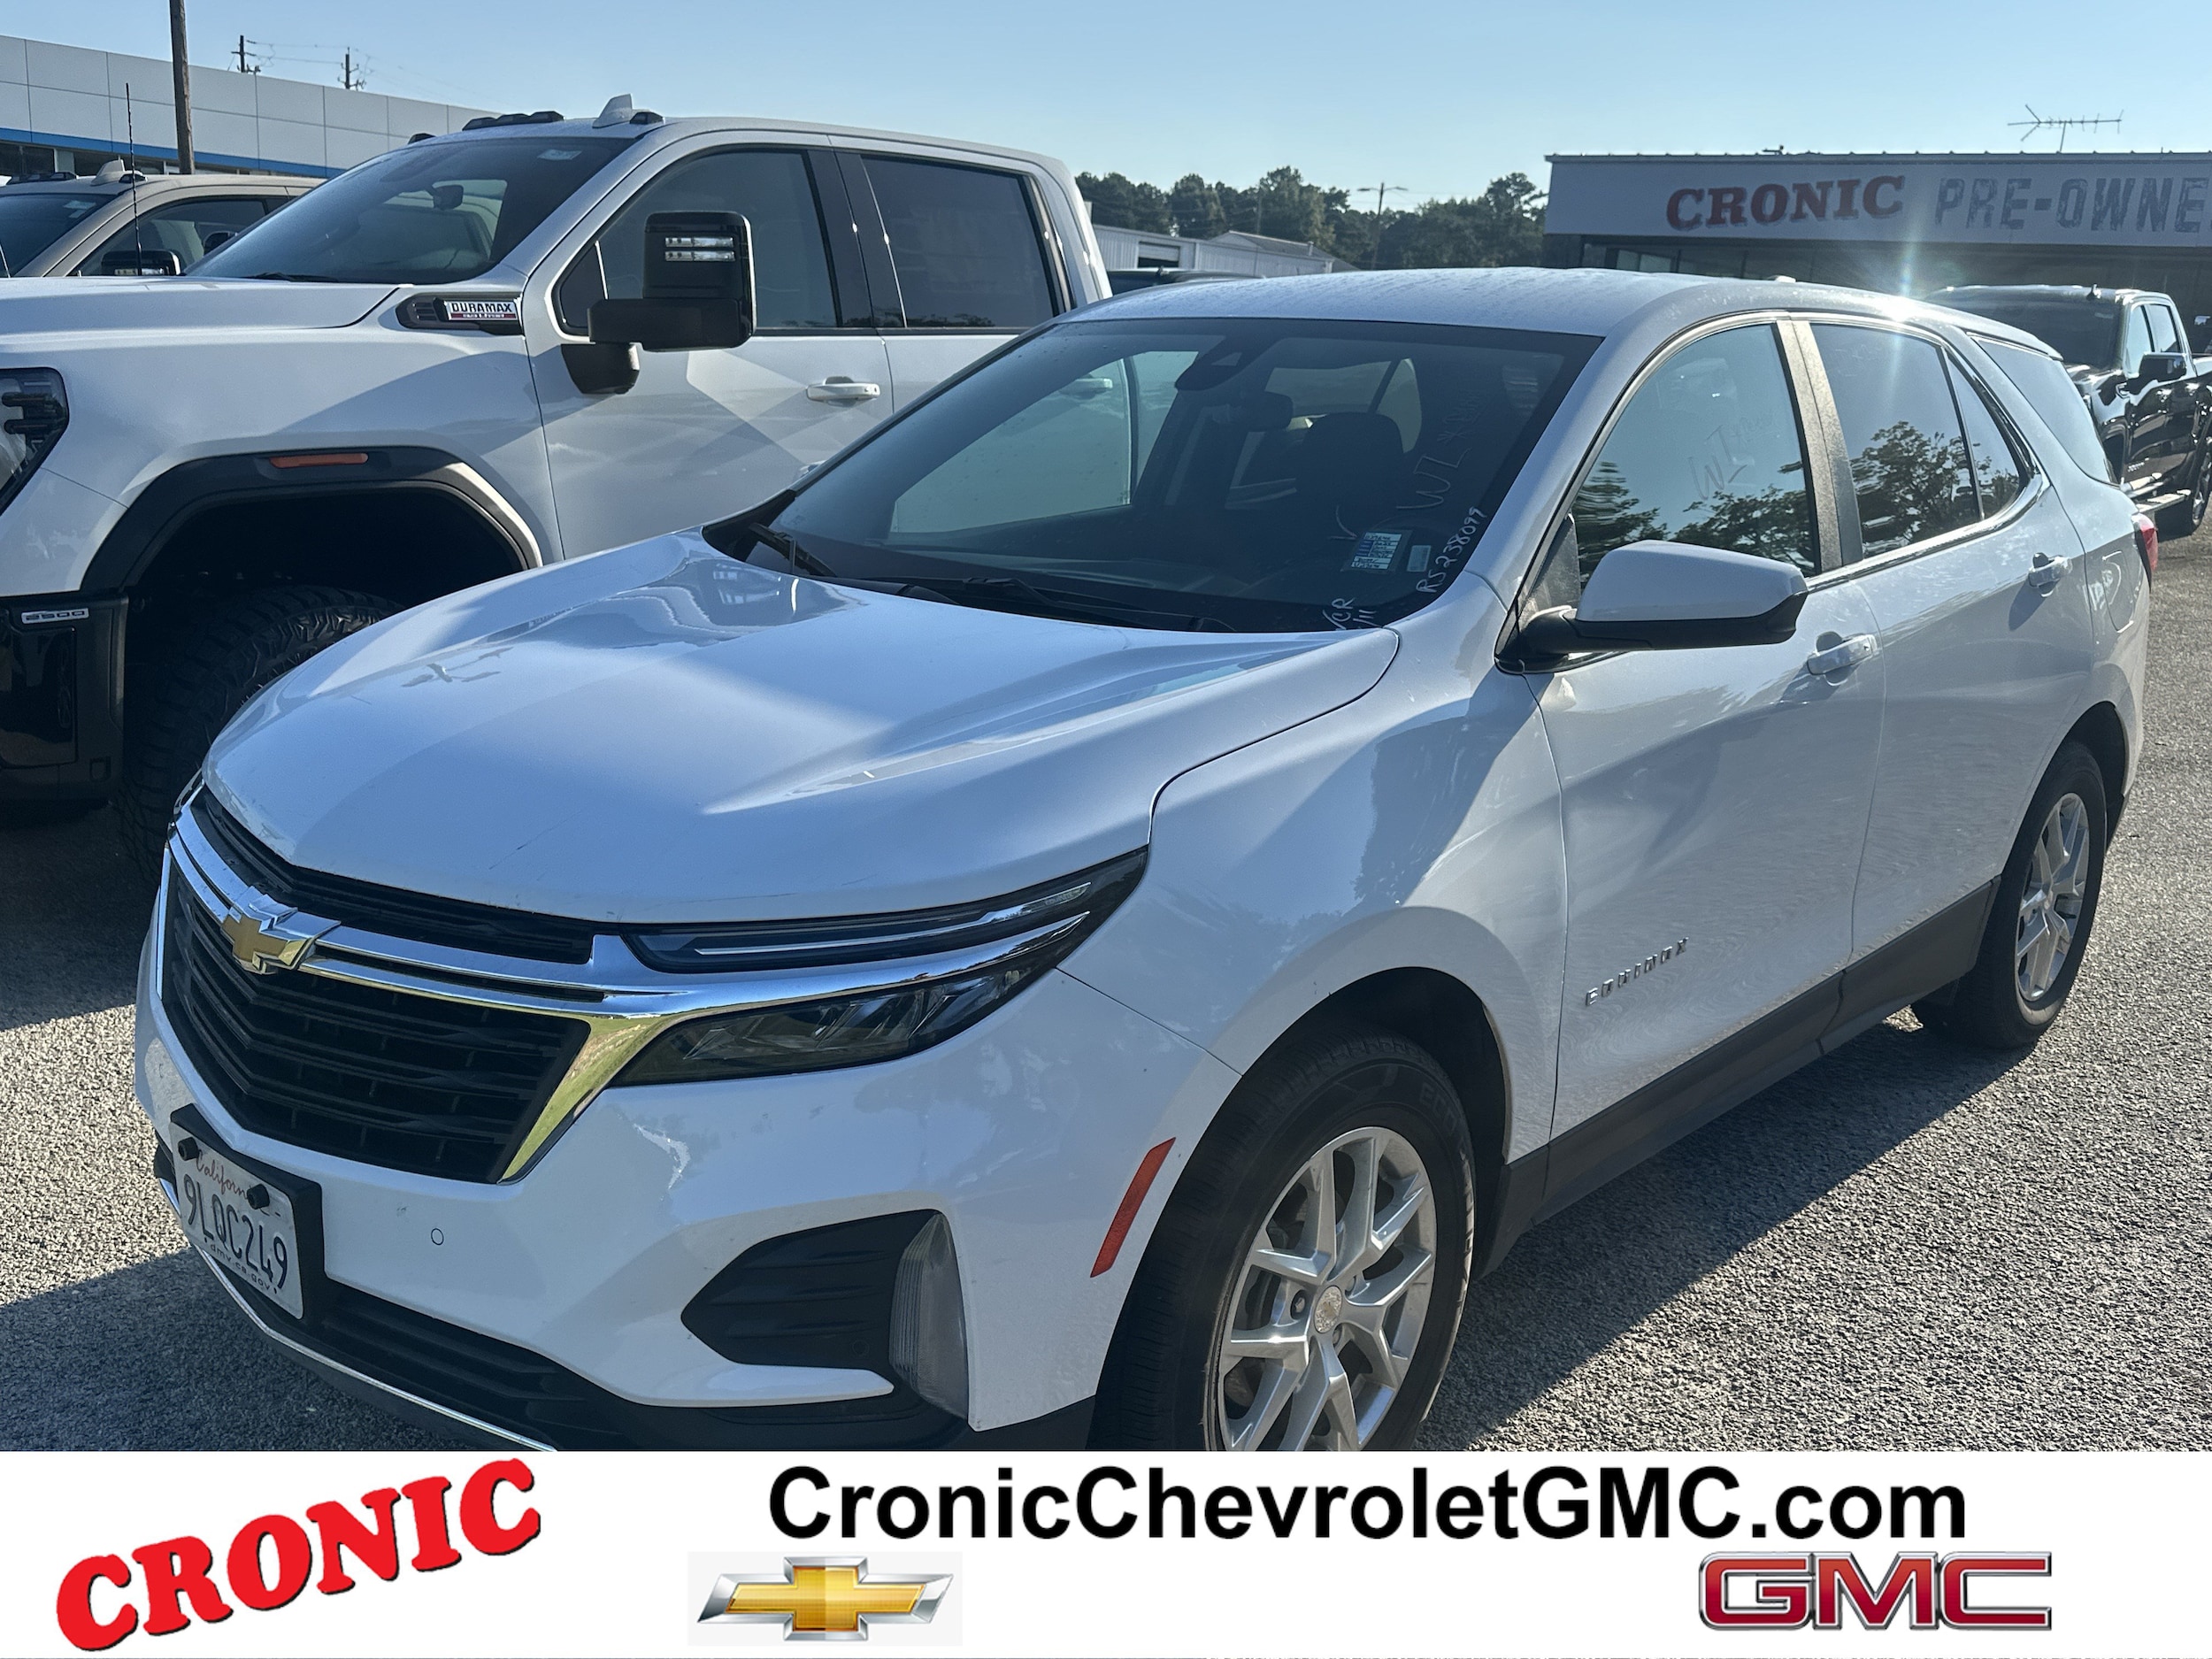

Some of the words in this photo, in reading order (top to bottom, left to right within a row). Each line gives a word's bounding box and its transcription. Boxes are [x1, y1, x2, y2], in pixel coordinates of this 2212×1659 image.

[1666, 175, 1905, 231] CRONIC
[1934, 177, 2212, 234] PRE-OWNE
[451, 303, 512, 312] DURAMAX
[1585, 936, 1689, 1007] EQUINOX
[195, 1149, 248, 1202] Californ
[183, 1173, 288, 1289] 9LQC249
